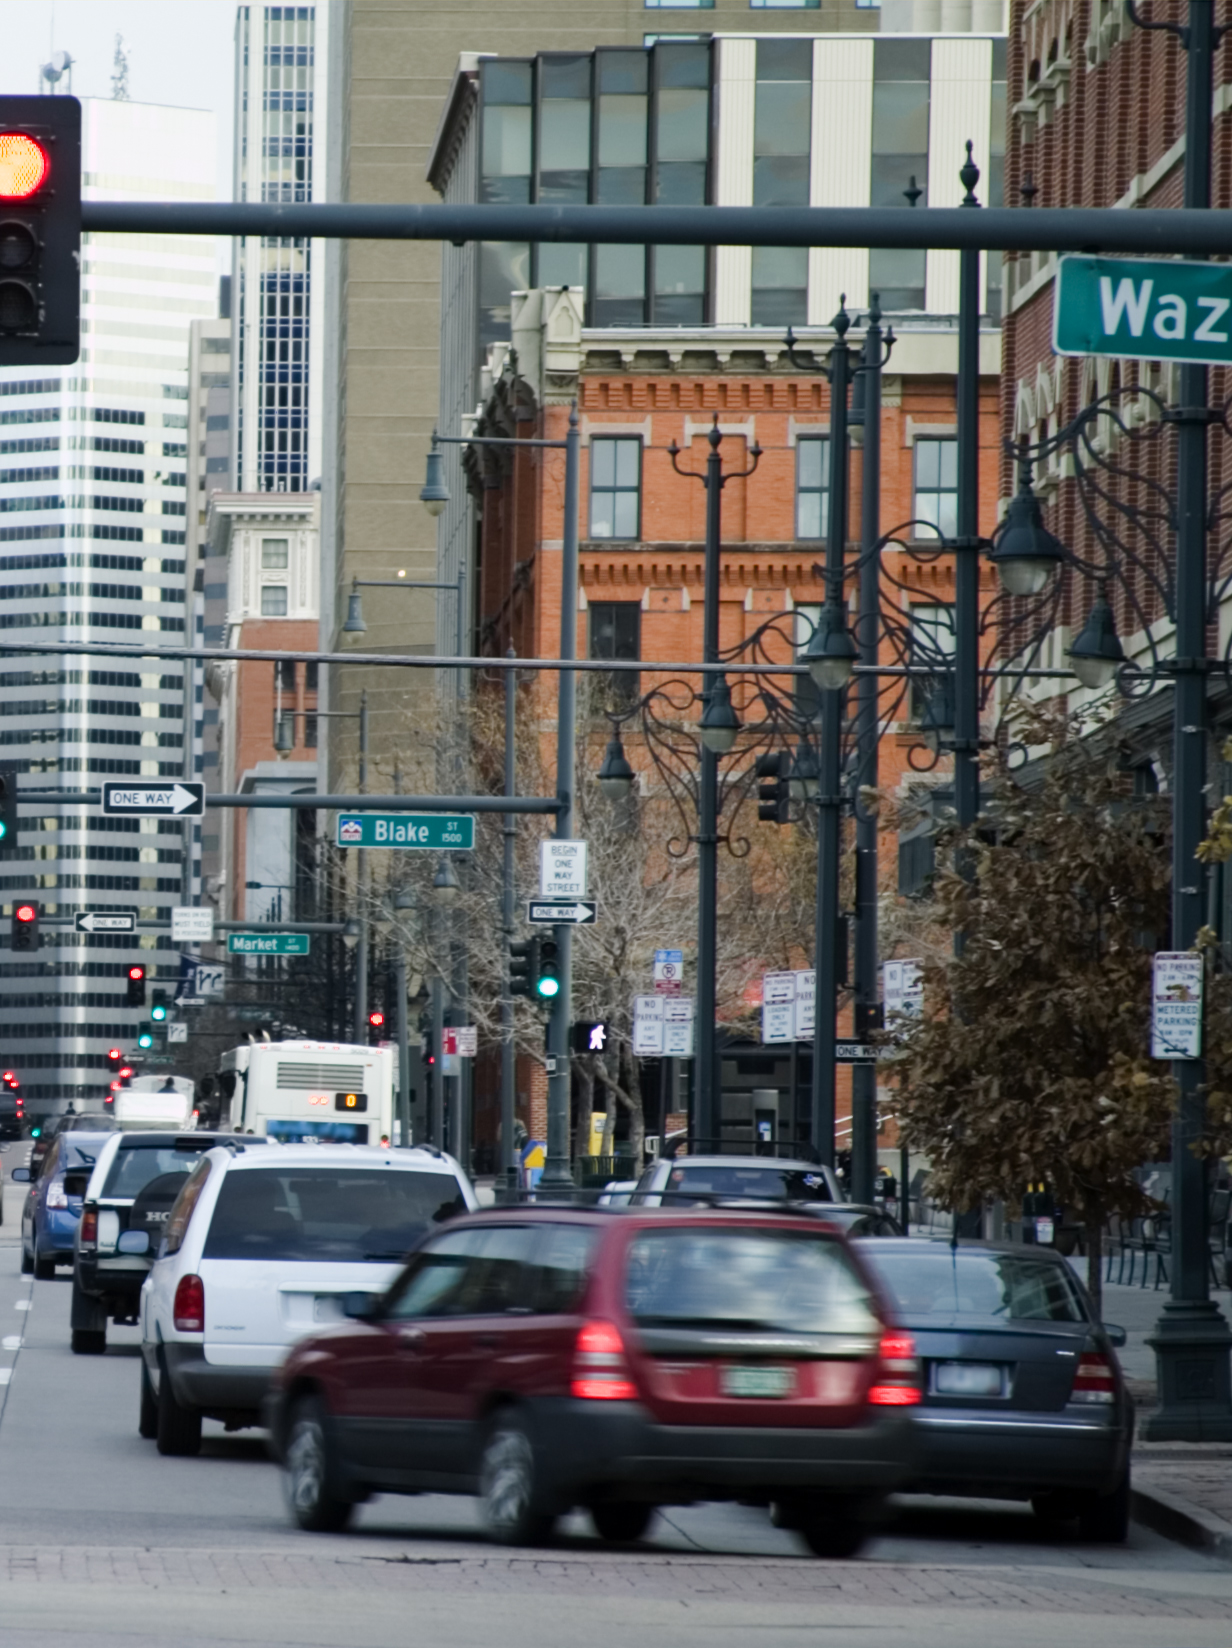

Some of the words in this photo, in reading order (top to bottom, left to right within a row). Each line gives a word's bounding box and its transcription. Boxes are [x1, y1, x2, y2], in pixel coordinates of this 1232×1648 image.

[1100, 276, 1231, 343] Waz
[113, 792, 140, 804] ONE
[145, 793, 173, 804] WAY
[374, 820, 429, 842] Blake
[447, 822, 458, 831] ST
[441, 833, 462, 842] 1500
[551, 846, 578, 855] BEGIN
[555, 860, 573, 868] ONE
[547, 883, 580, 892] STREET
[535, 908, 553, 916] ONE
[557, 909, 575, 917] WAY
[233, 937, 278, 950] Market
[1157, 963, 1167, 971] NO
[1170, 963, 1200, 971] PARKING
[804, 975, 816, 985] NO
[644, 1000, 656, 1008] NO
[1157, 1005, 1198, 1014] METERED
[1158, 1017, 1197, 1026] PARKING
[838, 1046, 858, 1056] ONE
[862, 1047, 884, 1056] WAY
